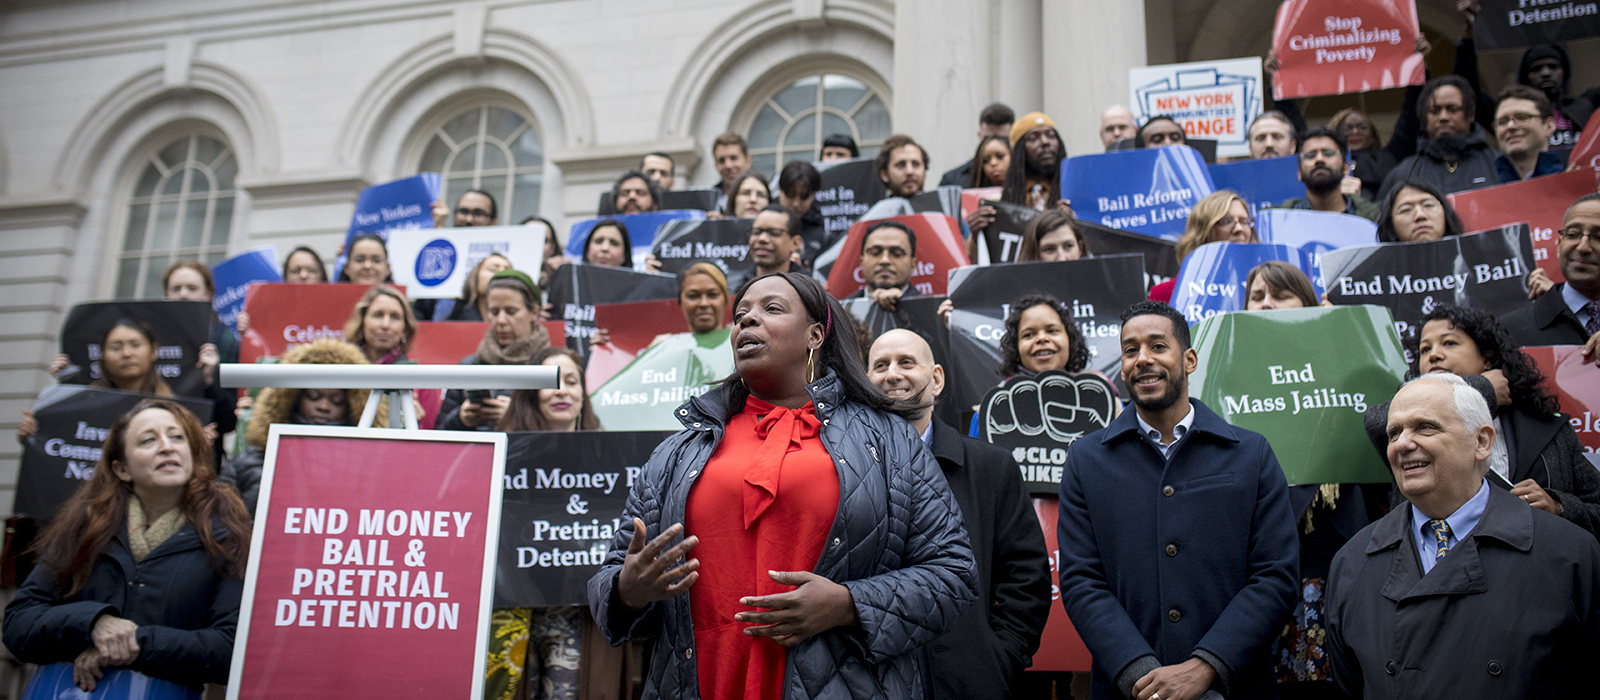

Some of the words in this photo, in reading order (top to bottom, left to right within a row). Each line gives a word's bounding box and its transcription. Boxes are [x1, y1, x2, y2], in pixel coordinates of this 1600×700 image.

[1324, 16, 1361, 32] Stop
[1508, 2, 1598, 27] Detention
[1289, 27, 1401, 51] Criminalizing
[1316, 46, 1376, 64] Poverty
[1157, 95, 1190, 110] NEW
[1195, 92, 1233, 106] YORK
[1184, 118, 1236, 135] ANGE
[815, 187, 836, 202] est
[838, 185, 854, 200] in
[1098, 194, 1129, 212] Bail
[1133, 188, 1192, 209] Reform
[820, 200, 869, 216] unities
[1101, 214, 1148, 230] Saves
[1150, 206, 1192, 225] Lives
[661, 242, 691, 259] End
[695, 242, 750, 262] Money
[1339, 275, 1383, 296] End
[1387, 272, 1469, 295] Money
[1473, 257, 1522, 285] Bail
[1187, 279, 1237, 299] New
[564, 303, 596, 321] Bail
[1072, 299, 1095, 318] in
[1421, 295, 1435, 315] &
[283, 324, 346, 342] Celebr
[564, 321, 598, 339] Save
[641, 367, 677, 384] End
[1268, 363, 1316, 385] End
[600, 389, 648, 407] Mass
[1224, 394, 1286, 415] Mass
[1290, 388, 1368, 415] Jailing
[75, 421, 110, 441] Inv
[1012, 446, 1067, 465] #CLO
[503, 467, 529, 490] nd
[535, 467, 620, 495] Money
[1019, 464, 1064, 483] RIKE
[566, 493, 589, 515] &
[284, 507, 349, 535] END
[357, 508, 473, 538] MONEY
[532, 518, 621, 542] Pretrial
[322, 538, 394, 566] BAIL
[403, 538, 426, 567] &
[516, 544, 607, 569] Detenti
[291, 568, 449, 598] PRETRIAL
[275, 599, 460, 630] DETENTION
